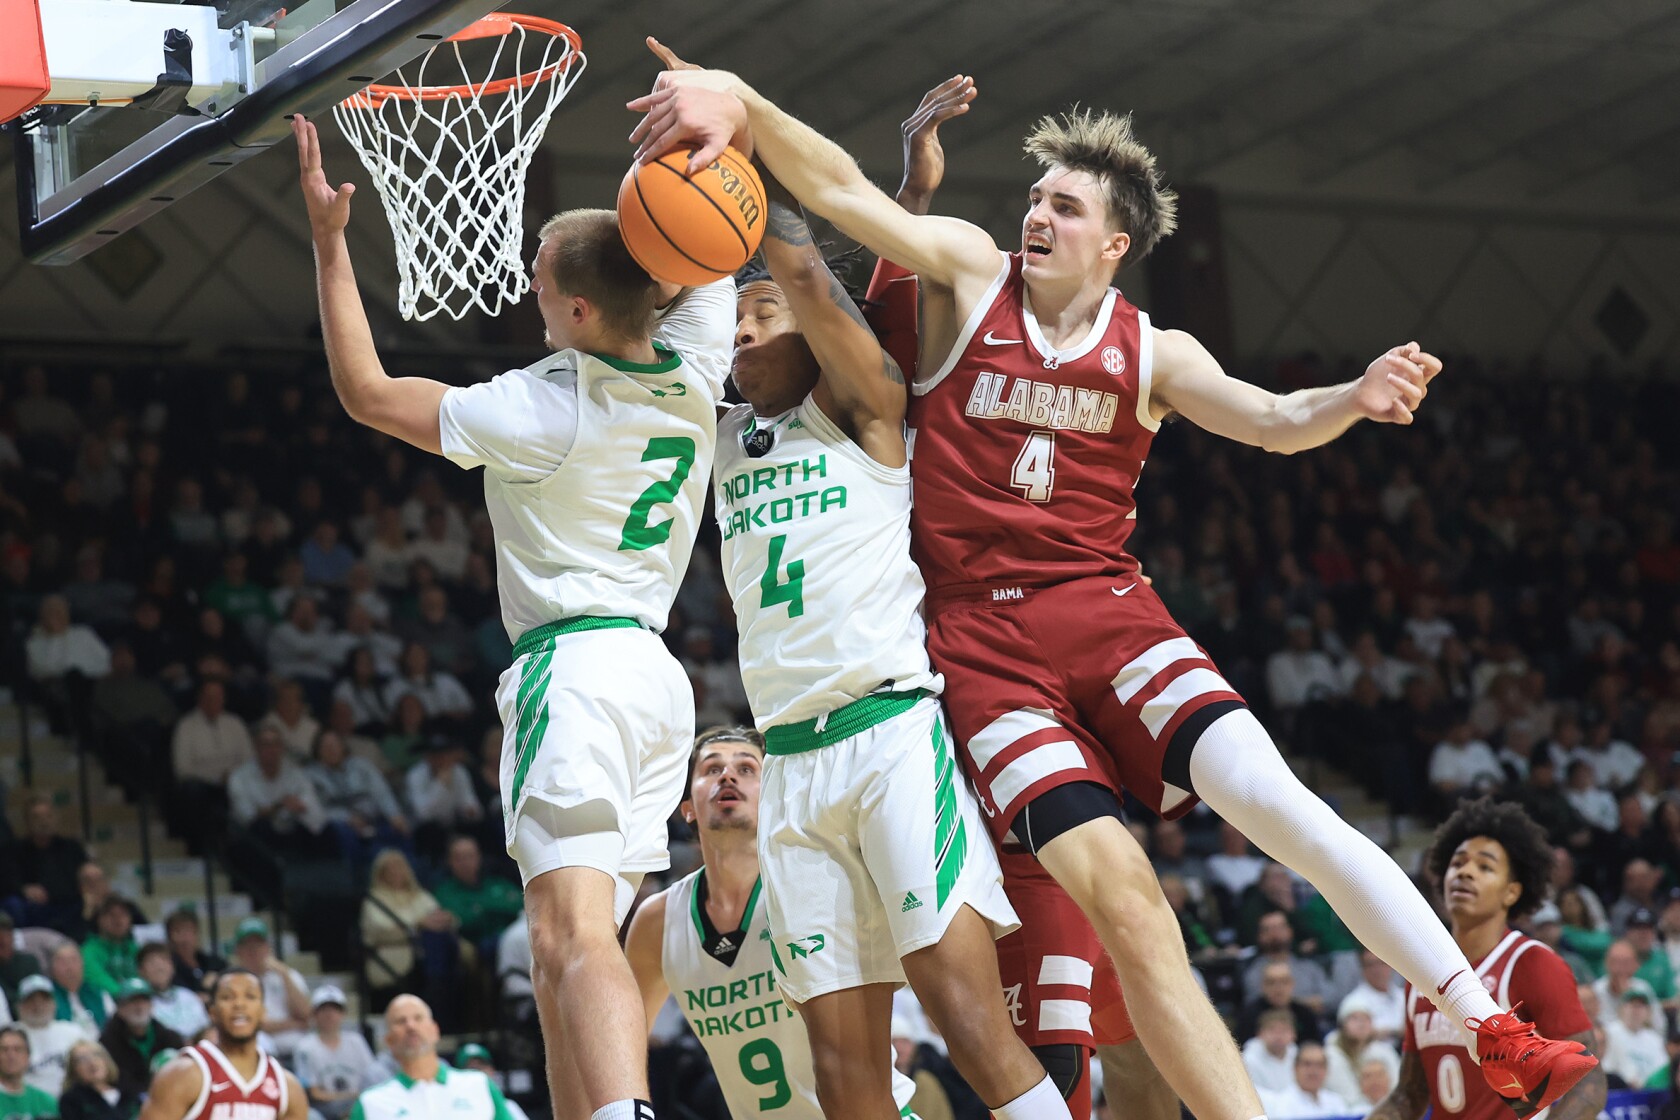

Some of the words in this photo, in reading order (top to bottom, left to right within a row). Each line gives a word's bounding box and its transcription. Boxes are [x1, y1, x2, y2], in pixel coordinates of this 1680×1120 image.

[687, 149, 760, 231] Wilso
[1103, 348, 1123, 373] SEC
[965, 371, 1119, 433] ALABAMA
[618, 436, 696, 551] 2
[722, 454, 827, 507] NORTH
[1010, 430, 1056, 503] 4
[723, 485, 848, 541] DAKOTA
[760, 534, 805, 619] 4
[991, 587, 1024, 601] BAMA
[901, 900, 923, 913] adidas
[693, 1000, 794, 1037] AKOT
[739, 1037, 792, 1112] 9
[1437, 1053, 1466, 1113] 0
